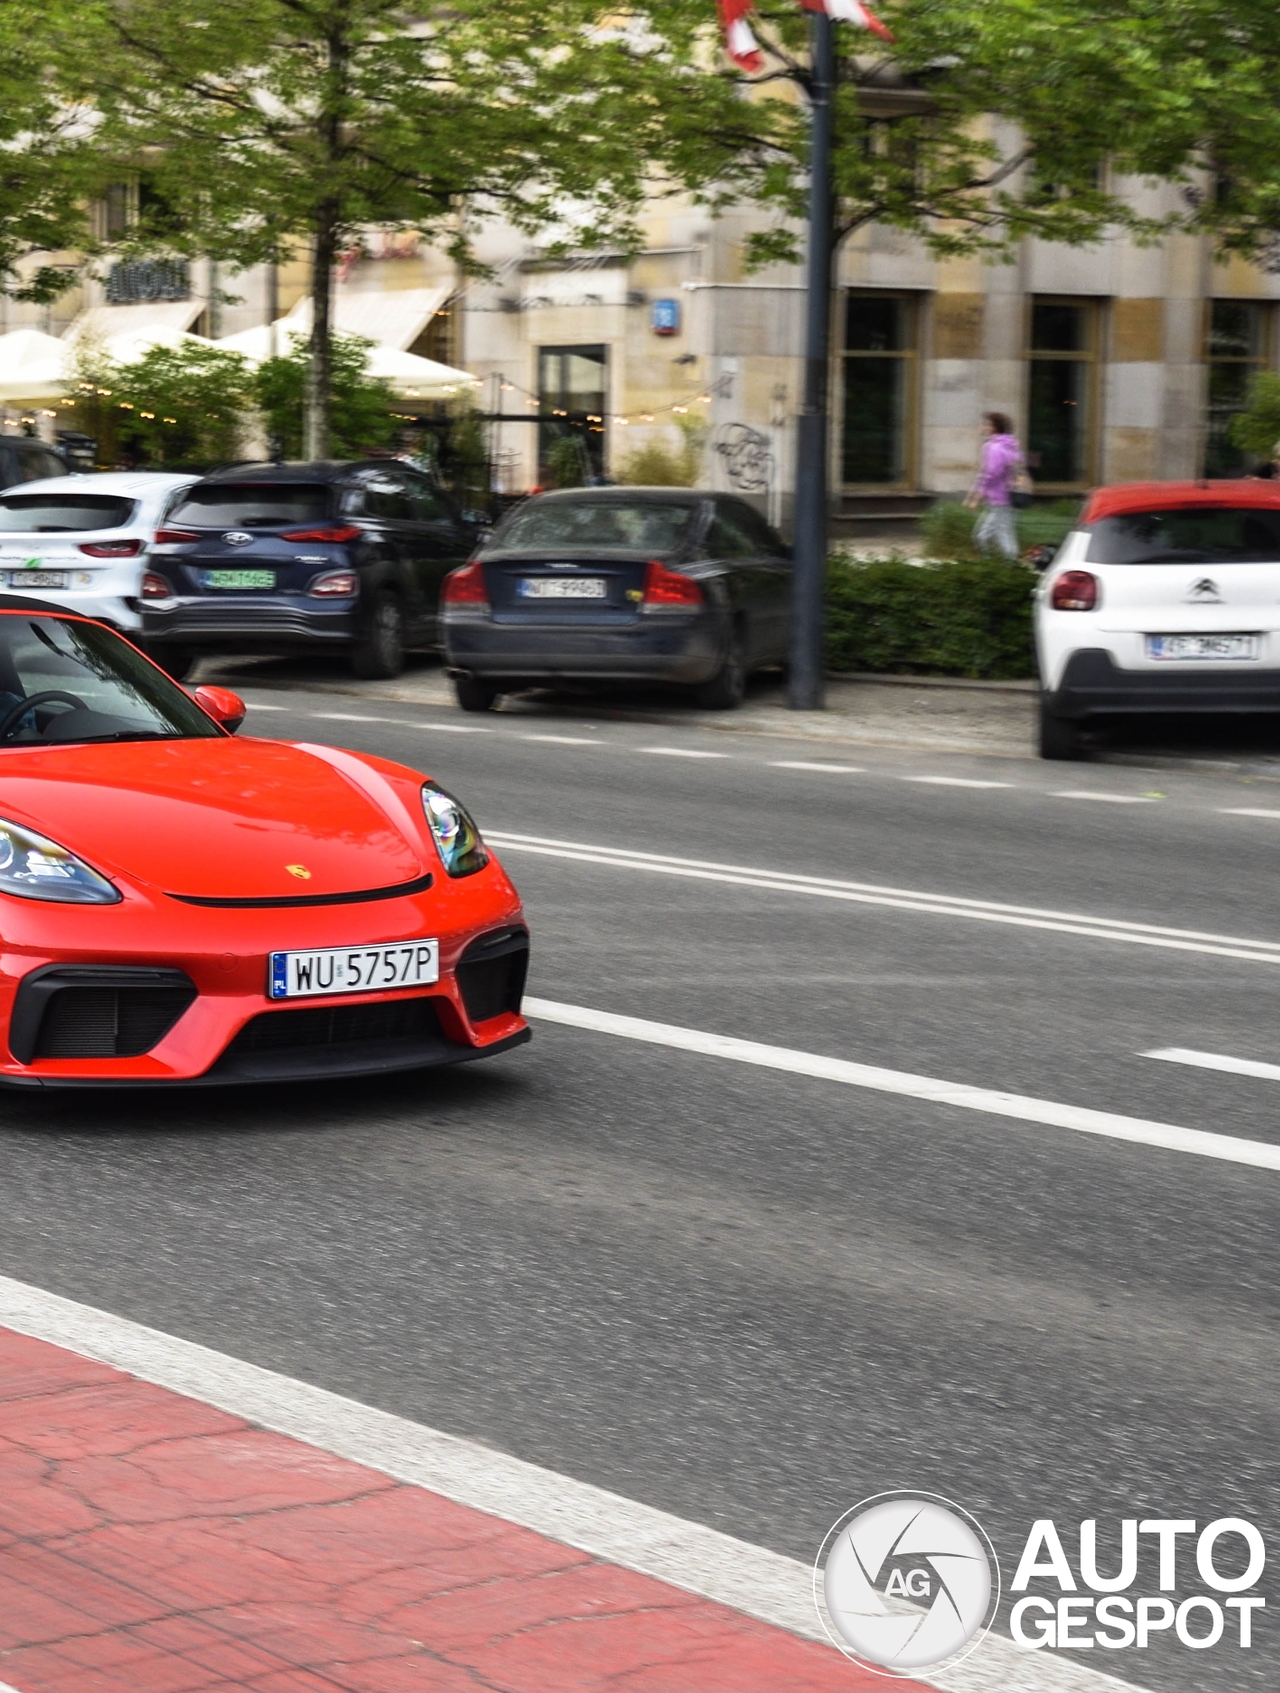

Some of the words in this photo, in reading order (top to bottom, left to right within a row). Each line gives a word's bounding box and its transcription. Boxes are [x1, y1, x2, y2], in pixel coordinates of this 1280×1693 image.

[296, 956, 334, 990] WU
[347, 946, 431, 986] 5757P
[273, 980, 287, 989] PL
